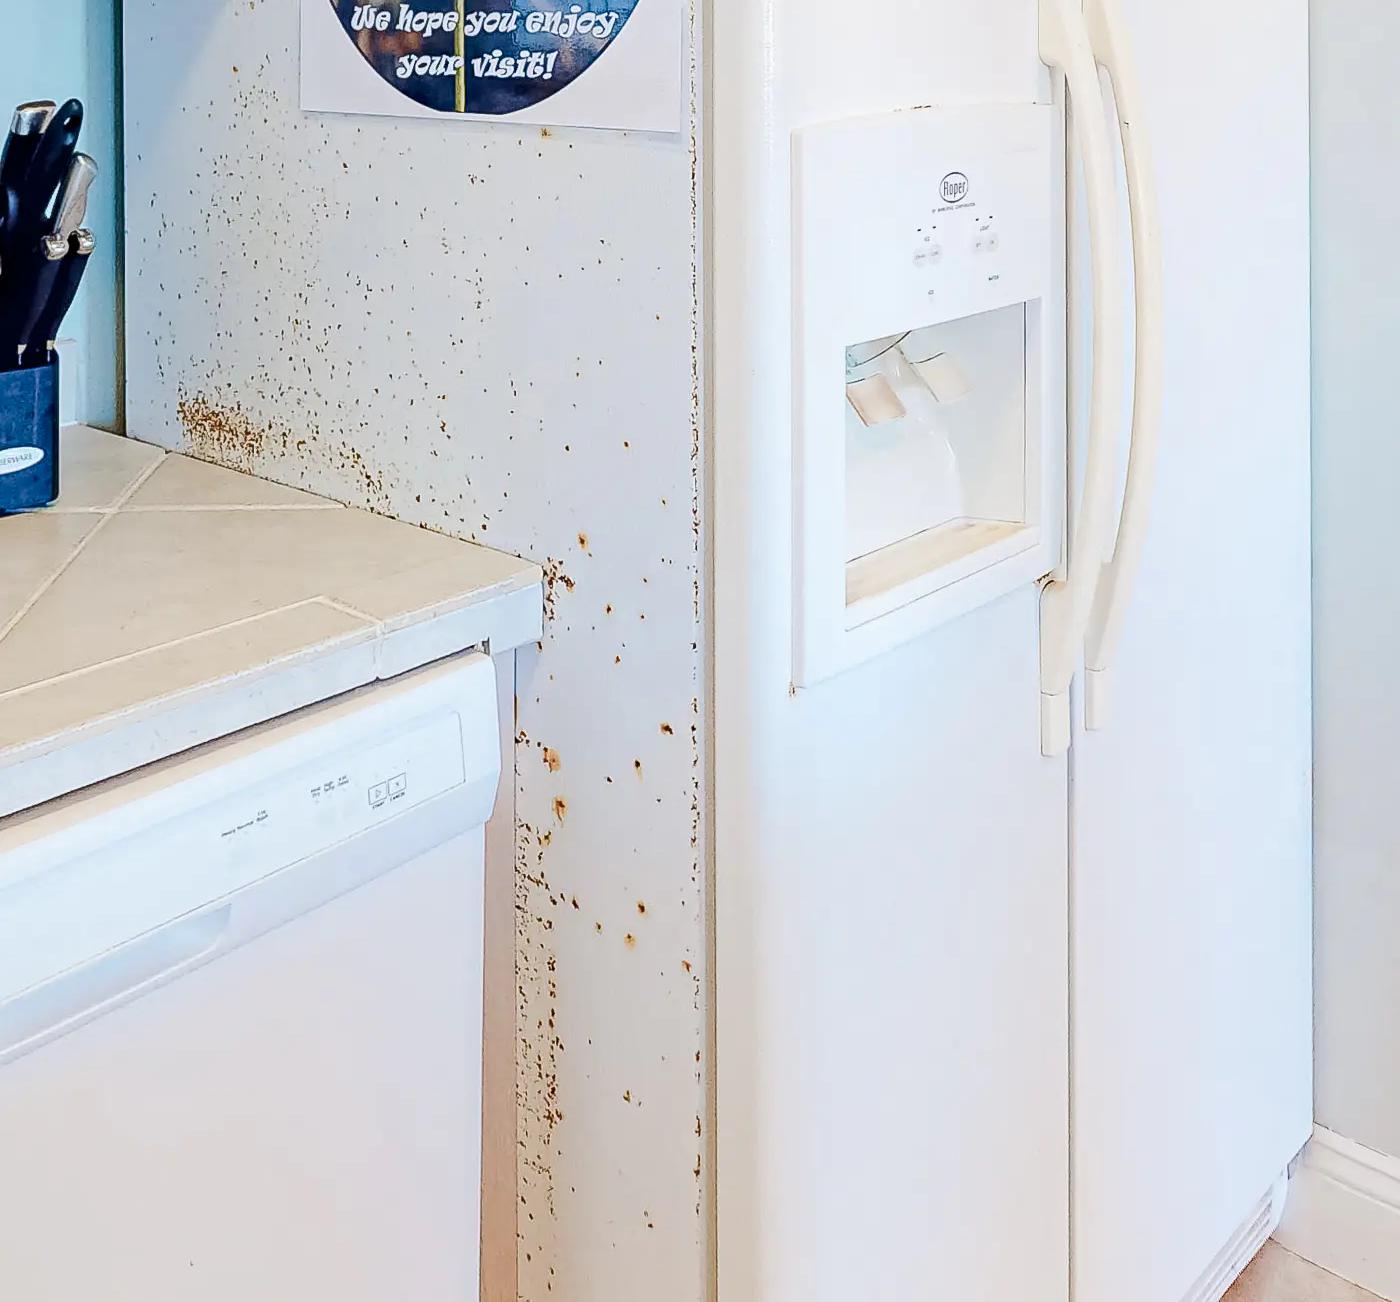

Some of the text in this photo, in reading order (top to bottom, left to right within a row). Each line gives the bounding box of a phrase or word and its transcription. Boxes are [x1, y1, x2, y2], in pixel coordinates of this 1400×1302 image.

[350, 4, 620, 39] We hope you enjoy
[396, 50, 559, 80] your visit!
[943, 181, 966, 198] Roper
